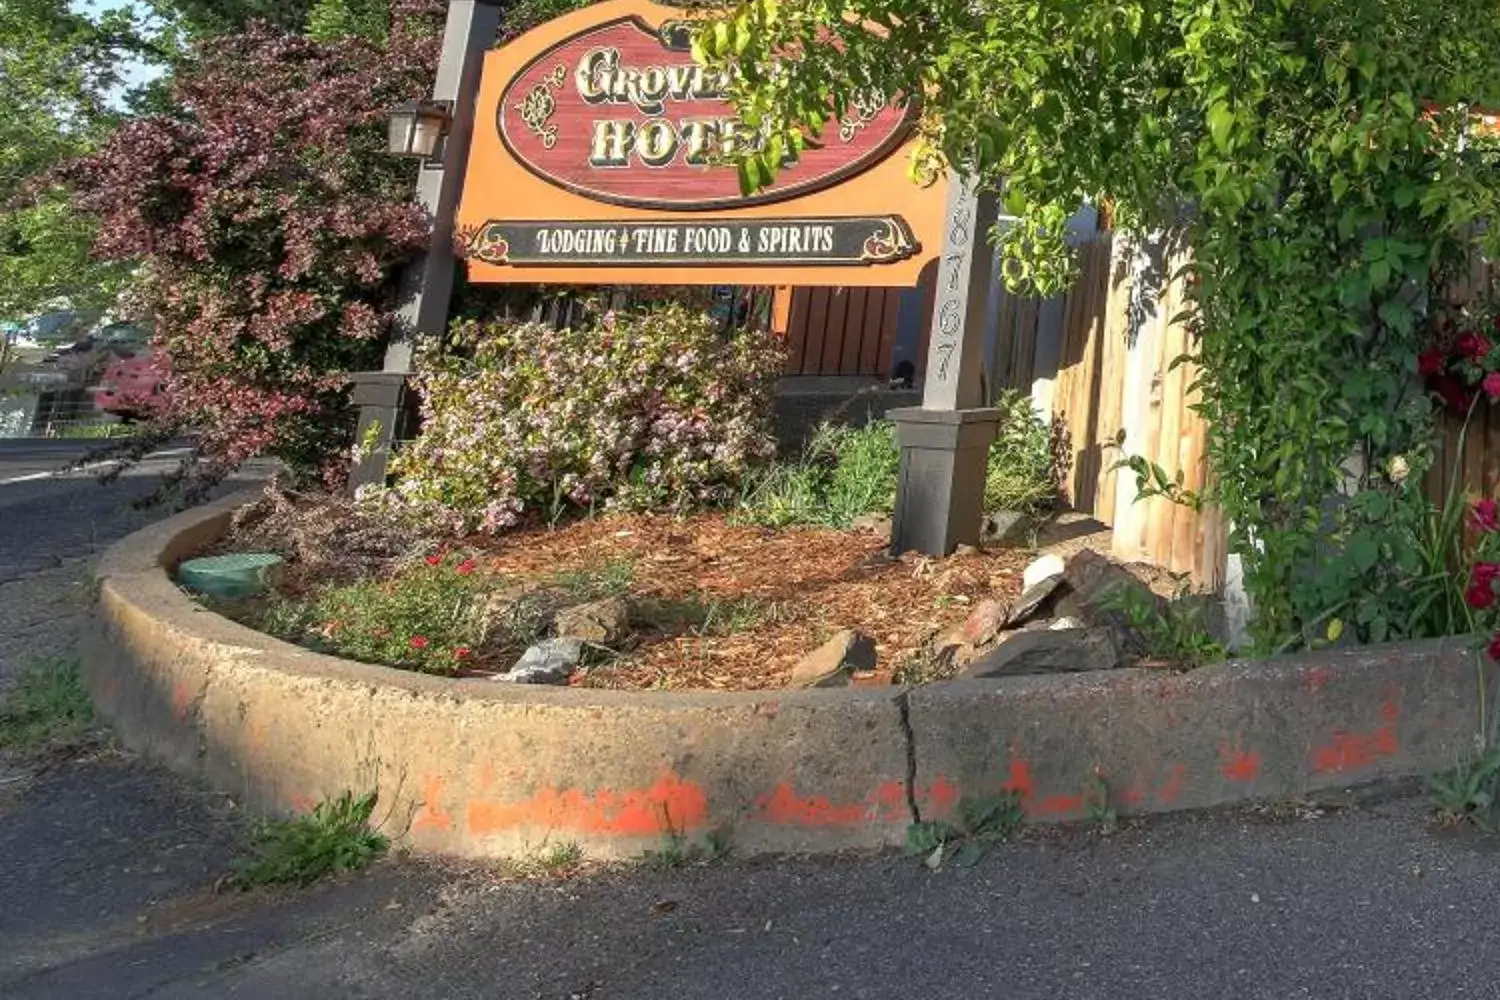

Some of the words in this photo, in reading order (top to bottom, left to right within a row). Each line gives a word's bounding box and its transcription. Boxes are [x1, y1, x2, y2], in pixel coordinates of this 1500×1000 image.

[537, 229, 616, 253] LODGING
[632, 229, 677, 252] FINE
[684, 228, 732, 252] FOOD
[738, 228, 750, 252] &
[758, 226, 834, 252] SPIRITS
